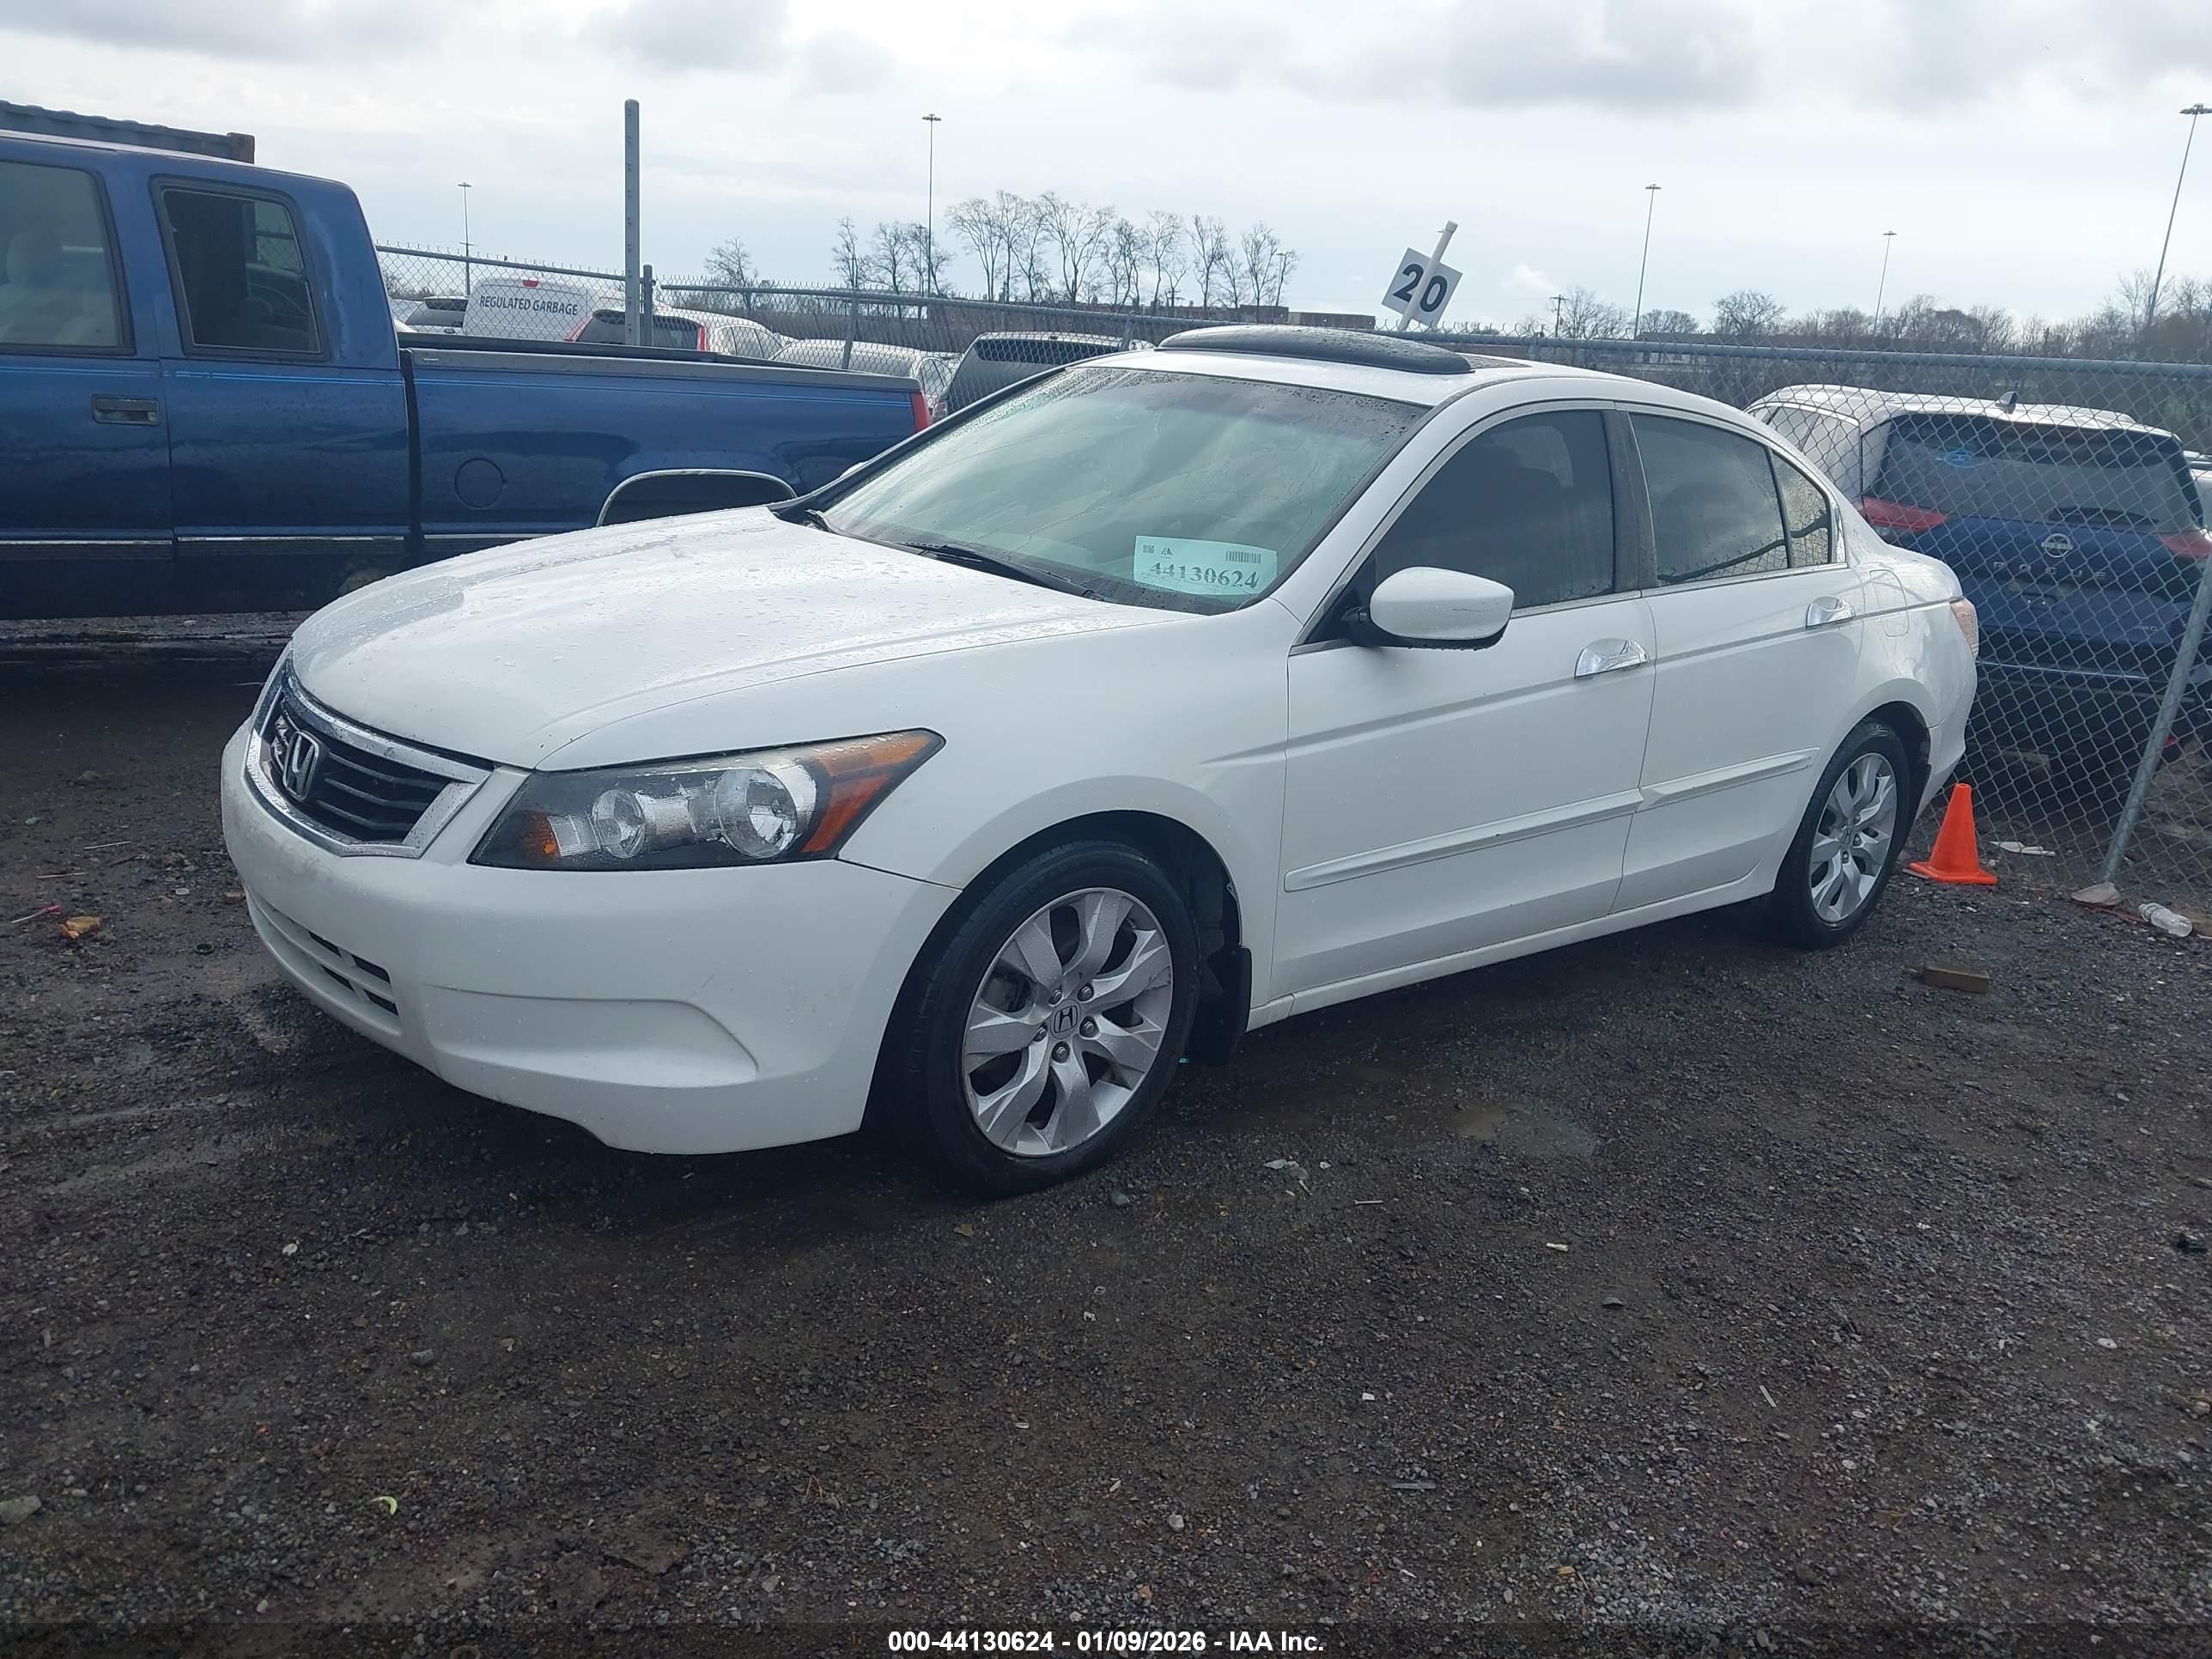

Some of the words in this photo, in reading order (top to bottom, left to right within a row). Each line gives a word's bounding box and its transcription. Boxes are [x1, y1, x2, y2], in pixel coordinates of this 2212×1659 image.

[1392, 263, 1448, 313] 20
[479, 295, 532, 311] REGULATED
[532, 300, 578, 316] GARBAGE
[1149, 562, 1261, 589] 44130624
